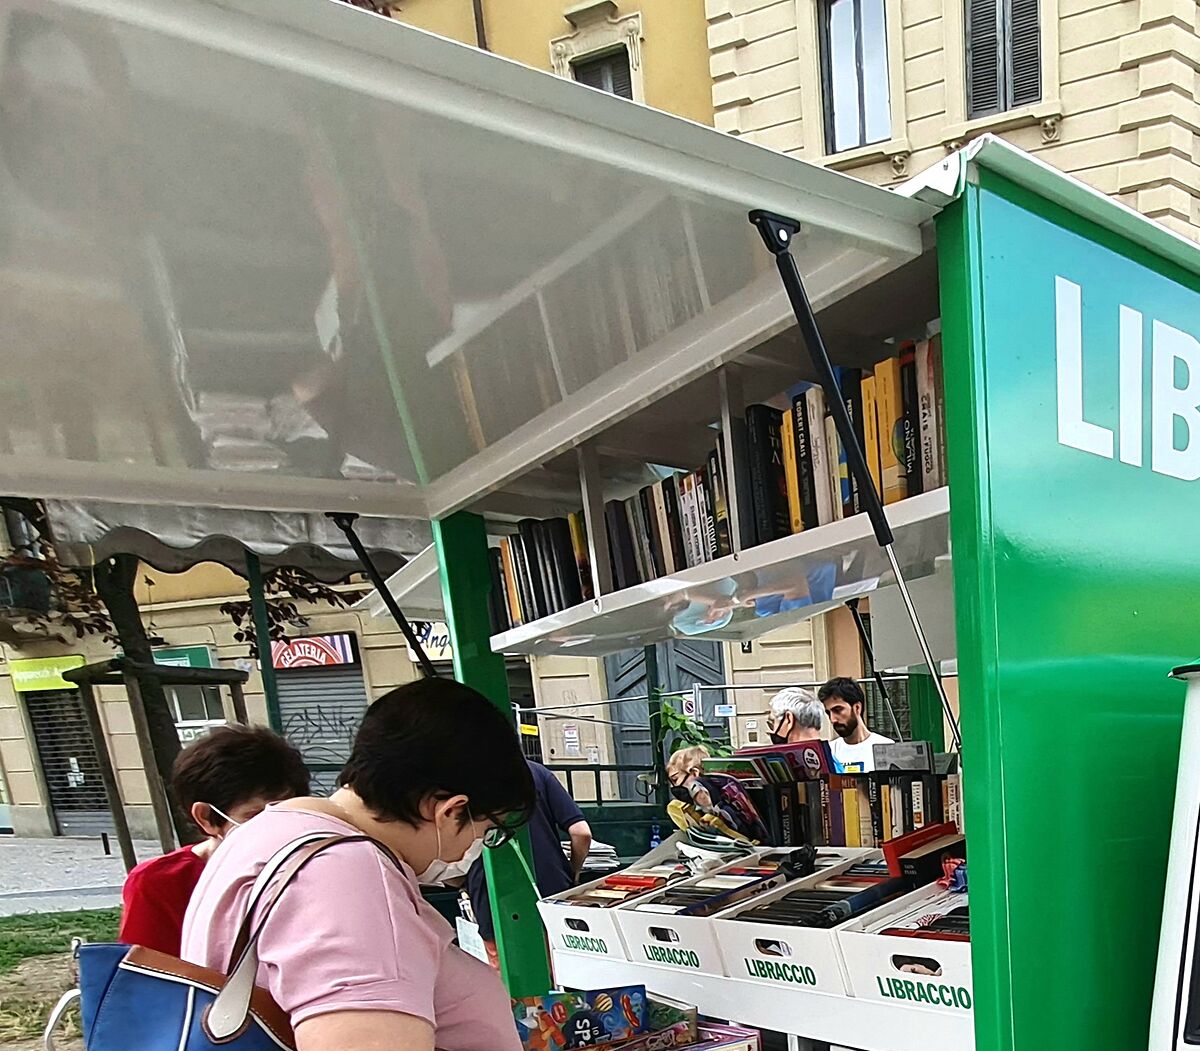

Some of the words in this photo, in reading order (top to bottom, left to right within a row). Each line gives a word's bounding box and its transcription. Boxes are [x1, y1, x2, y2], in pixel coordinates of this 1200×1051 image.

[420, 624, 452, 656] Ang
[281, 643, 327, 668] GELATERIA
[562, 934, 608, 954] LIBRACCIO
[642, 944, 700, 968] LIBRACCIO
[744, 958, 817, 986] LIBRACCIO
[876, 976, 972, 1009] LIBRACCIO
